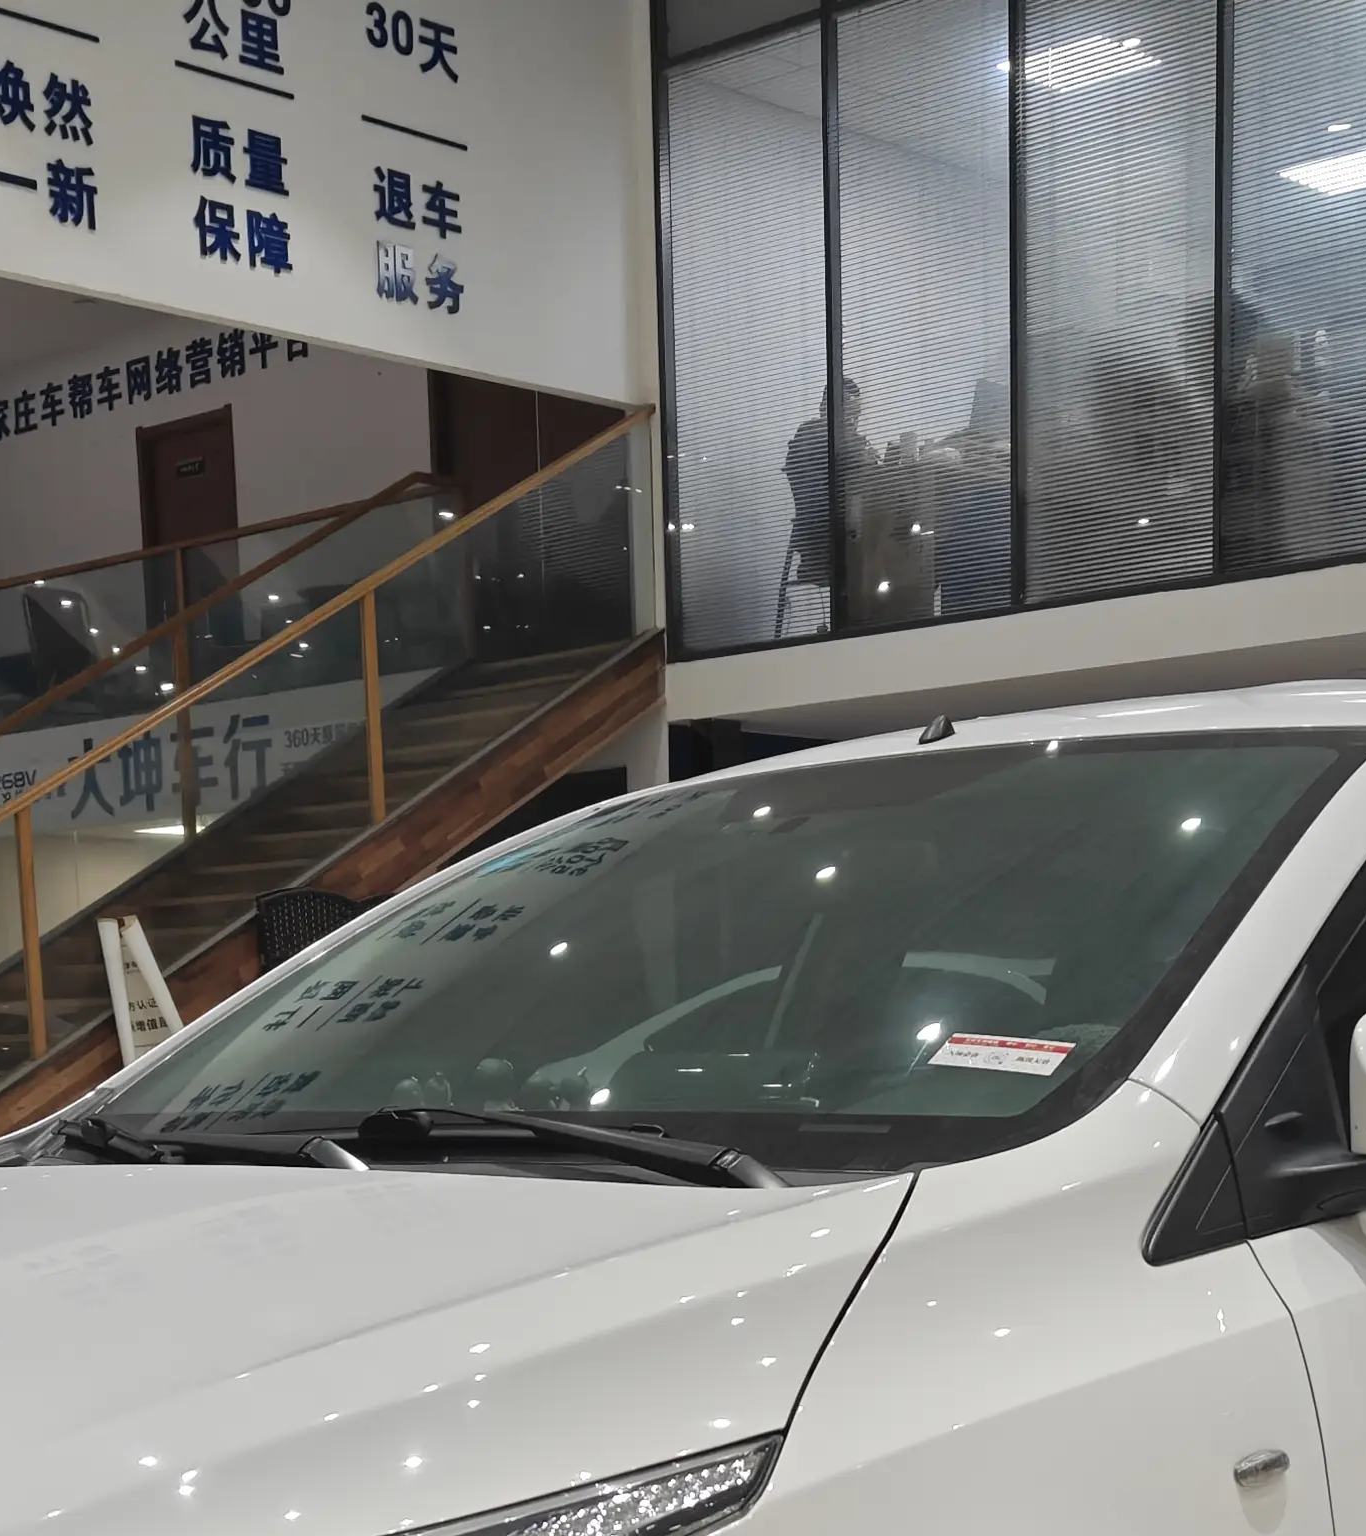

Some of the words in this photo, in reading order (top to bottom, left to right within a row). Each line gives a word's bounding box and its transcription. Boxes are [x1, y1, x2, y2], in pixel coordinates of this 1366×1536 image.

[364, 2, 460, 84] 30天
[190, 114, 291, 198] 质量
[193, 197, 294, 275] 保障
[373, 165, 463, 240] 退车
[375, 240, 466, 316] 服务
